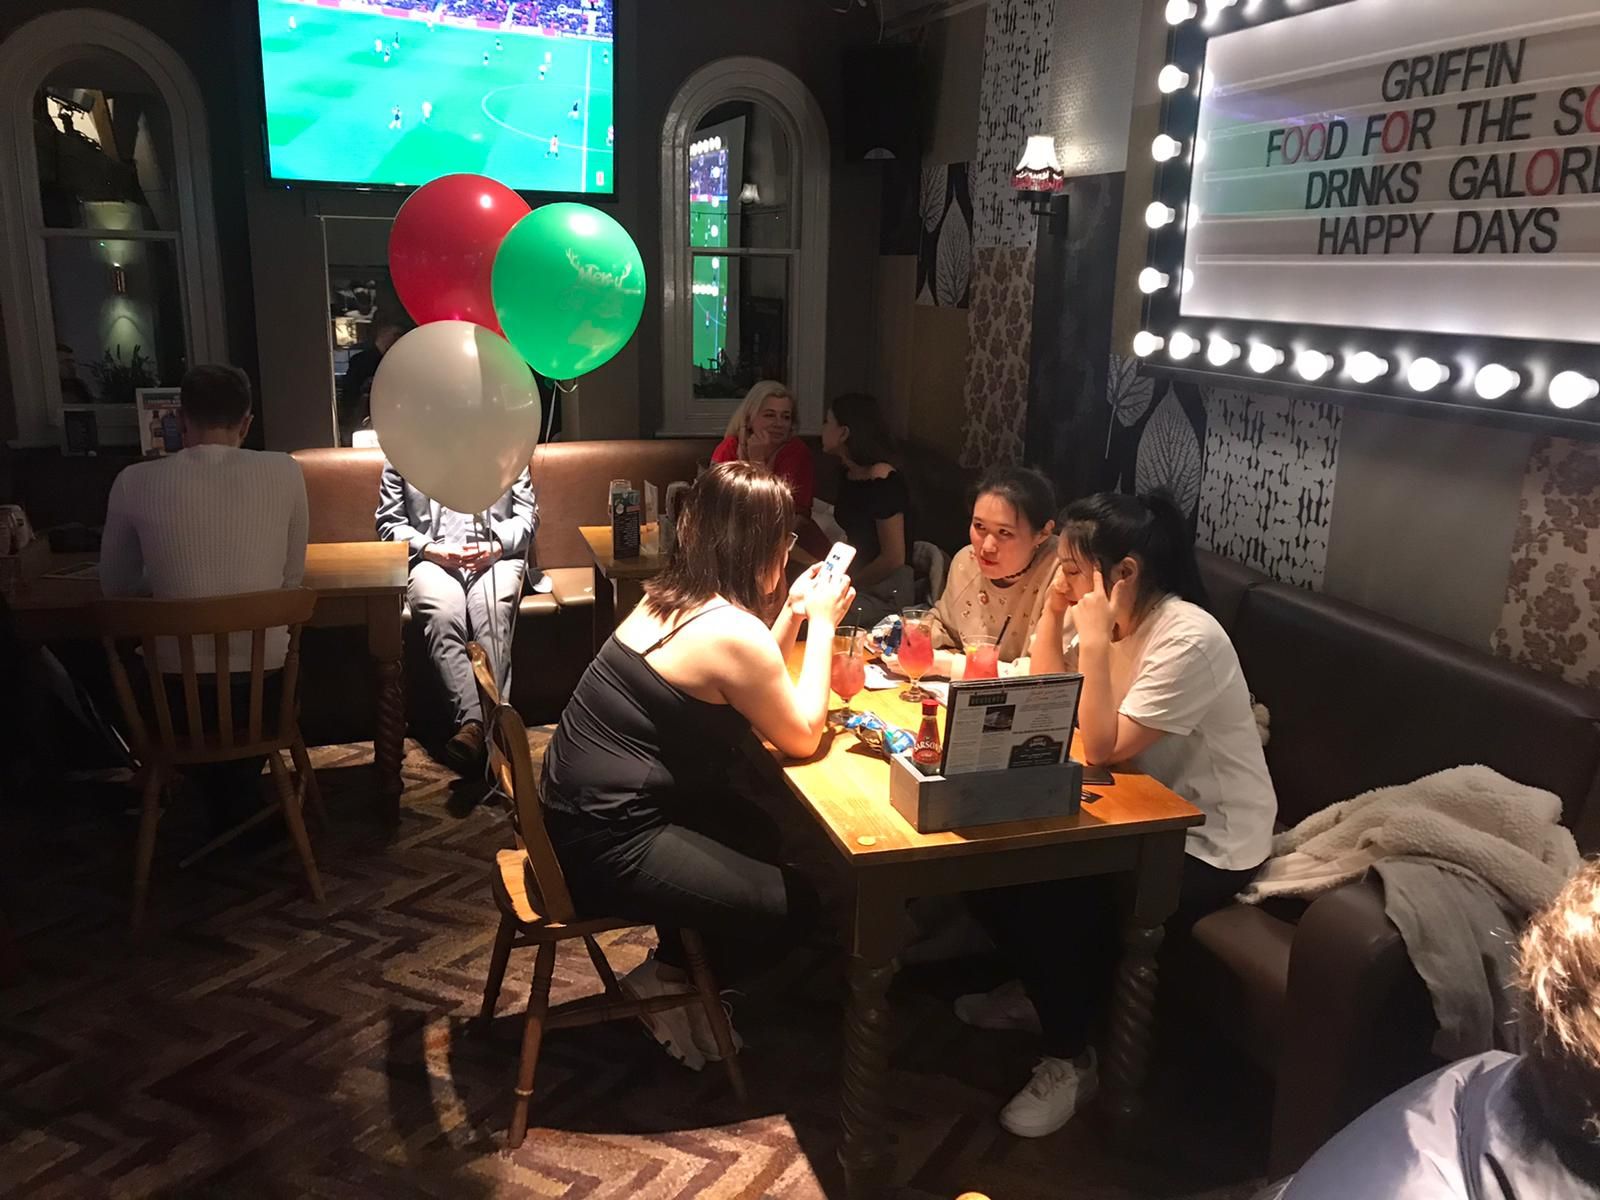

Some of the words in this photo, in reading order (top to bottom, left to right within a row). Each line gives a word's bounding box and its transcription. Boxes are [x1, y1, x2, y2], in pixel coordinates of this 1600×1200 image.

[1382, 38, 1527, 103] GRIFFIN
[1266, 121, 1349, 167] FOOD
[1362, 108, 1436, 156] FOR
[1457, 93, 1537, 146] THE
[1305, 161, 1422, 210] DRINKS
[1449, 146, 1600, 201] GALOR
[1317, 212, 1434, 255] HAPPY
[1452, 206, 1560, 255] DAYS
